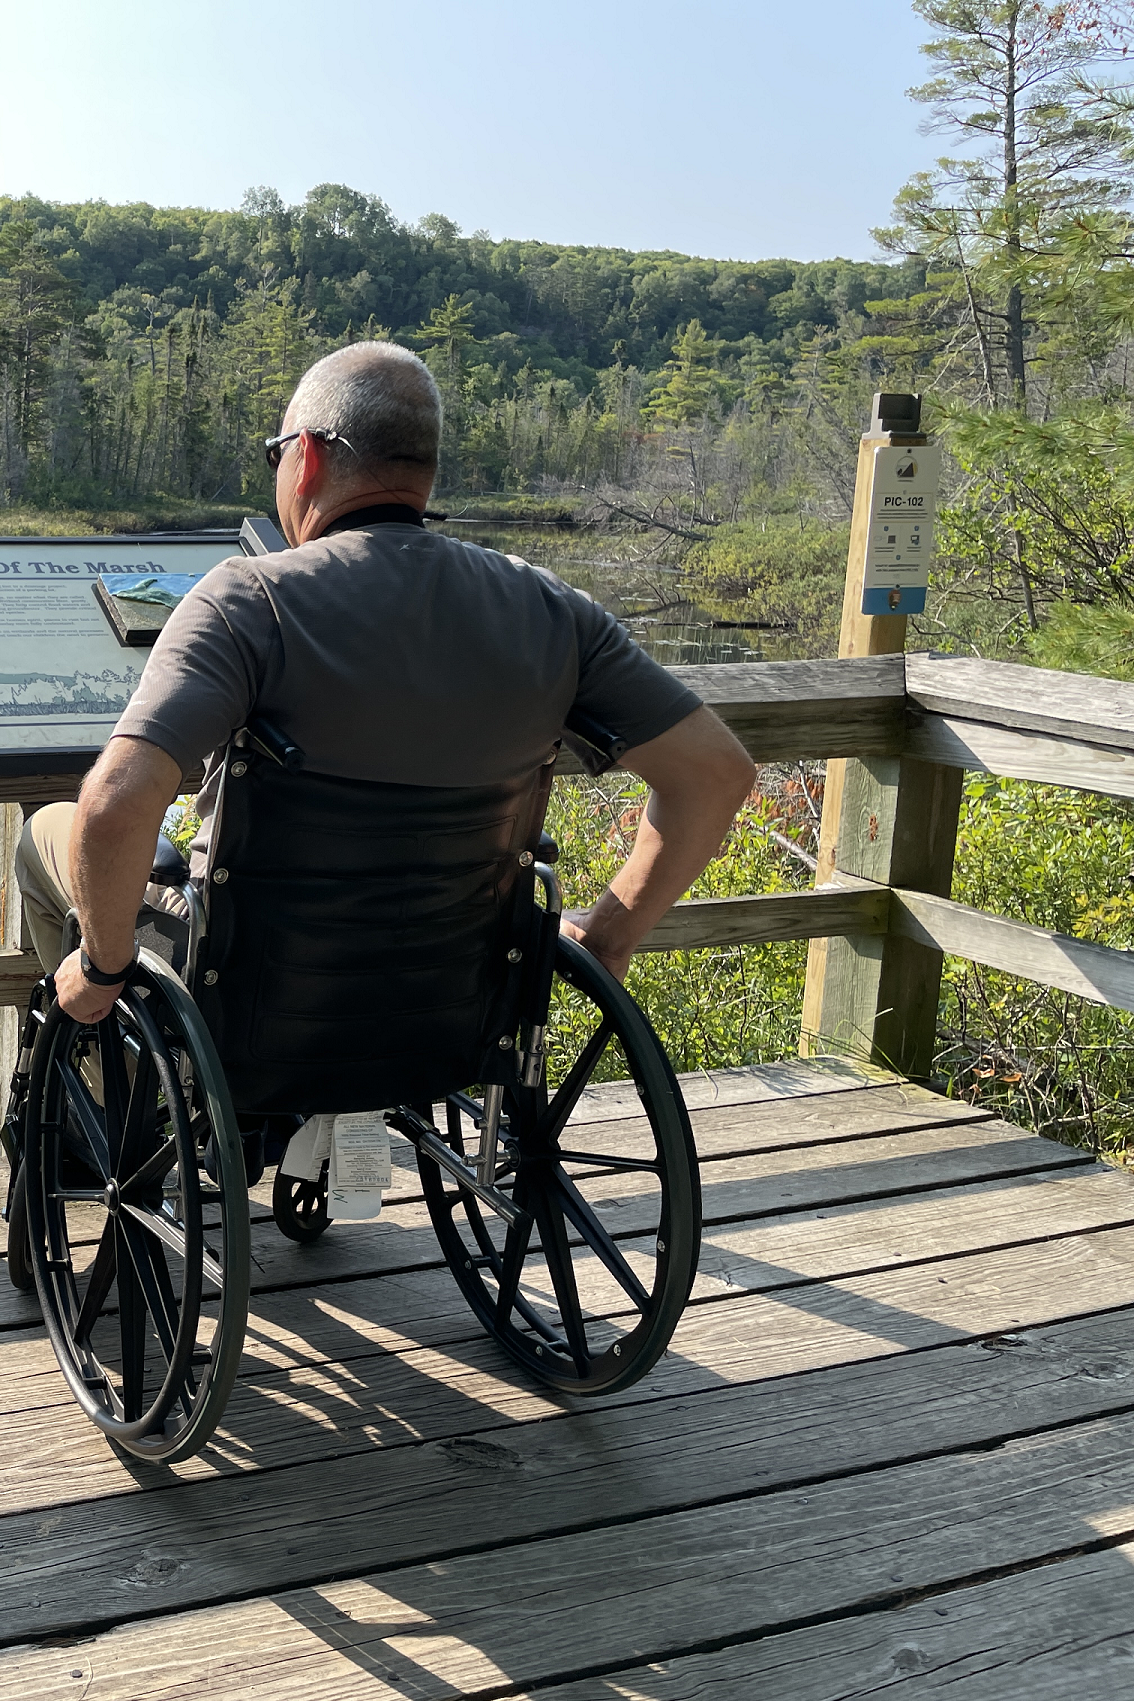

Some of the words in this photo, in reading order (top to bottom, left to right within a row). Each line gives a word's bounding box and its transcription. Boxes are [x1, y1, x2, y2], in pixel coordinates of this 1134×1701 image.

[884, 496, 923, 506] PIC-102
[28, 561, 80, 574] The
[83, 561, 167, 574] Marsh
